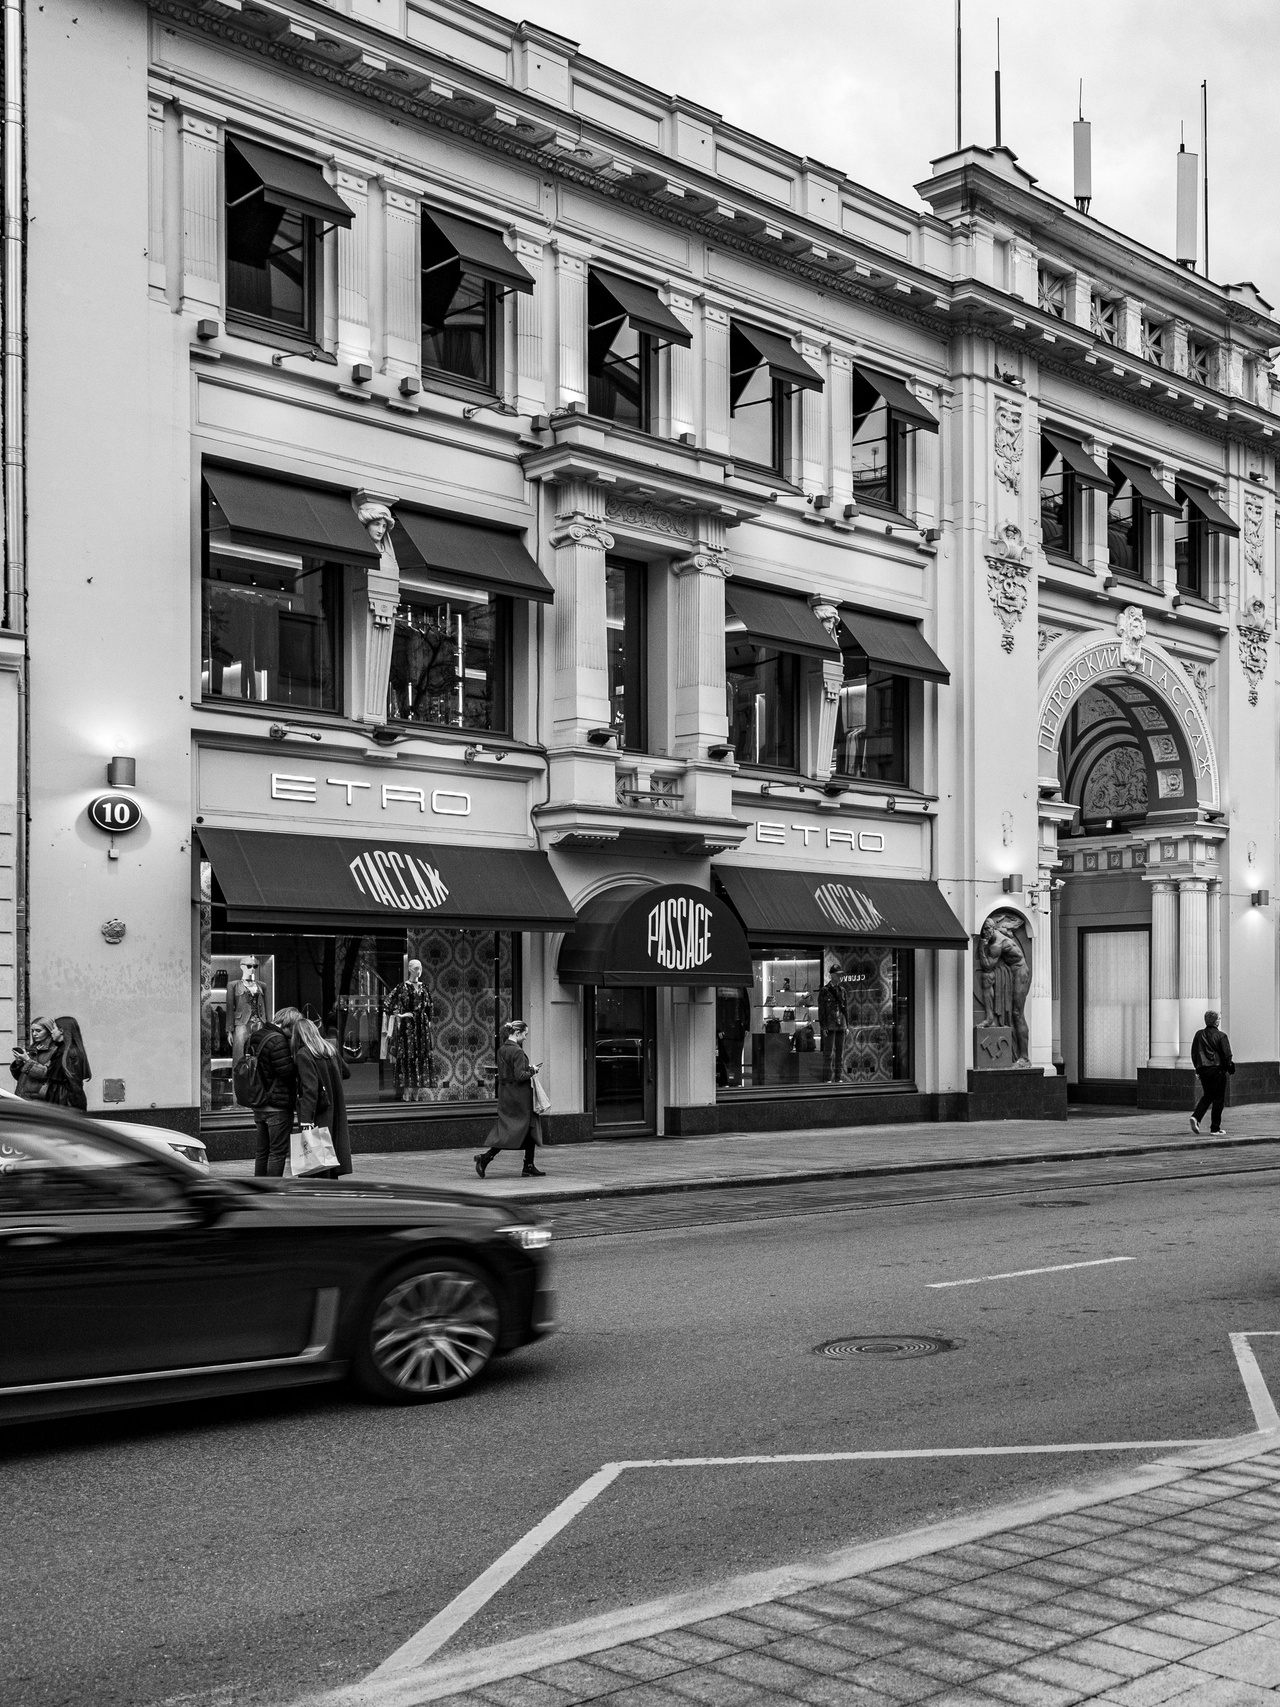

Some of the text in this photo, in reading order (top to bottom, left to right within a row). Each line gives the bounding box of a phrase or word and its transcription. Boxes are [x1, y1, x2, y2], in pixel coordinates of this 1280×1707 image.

[1038, 646, 1212, 778] ПЕТРОВСКИЙ ПАССАЖ
[101, 802, 129, 824] 10
[271, 773, 471, 816] ETRO
[755, 821, 885, 852] ETRO
[348, 850, 449, 910] ПАССАЖ
[814, 882, 884, 932] ПАССАЖ
[647, 897, 713, 970] PASSAGE
